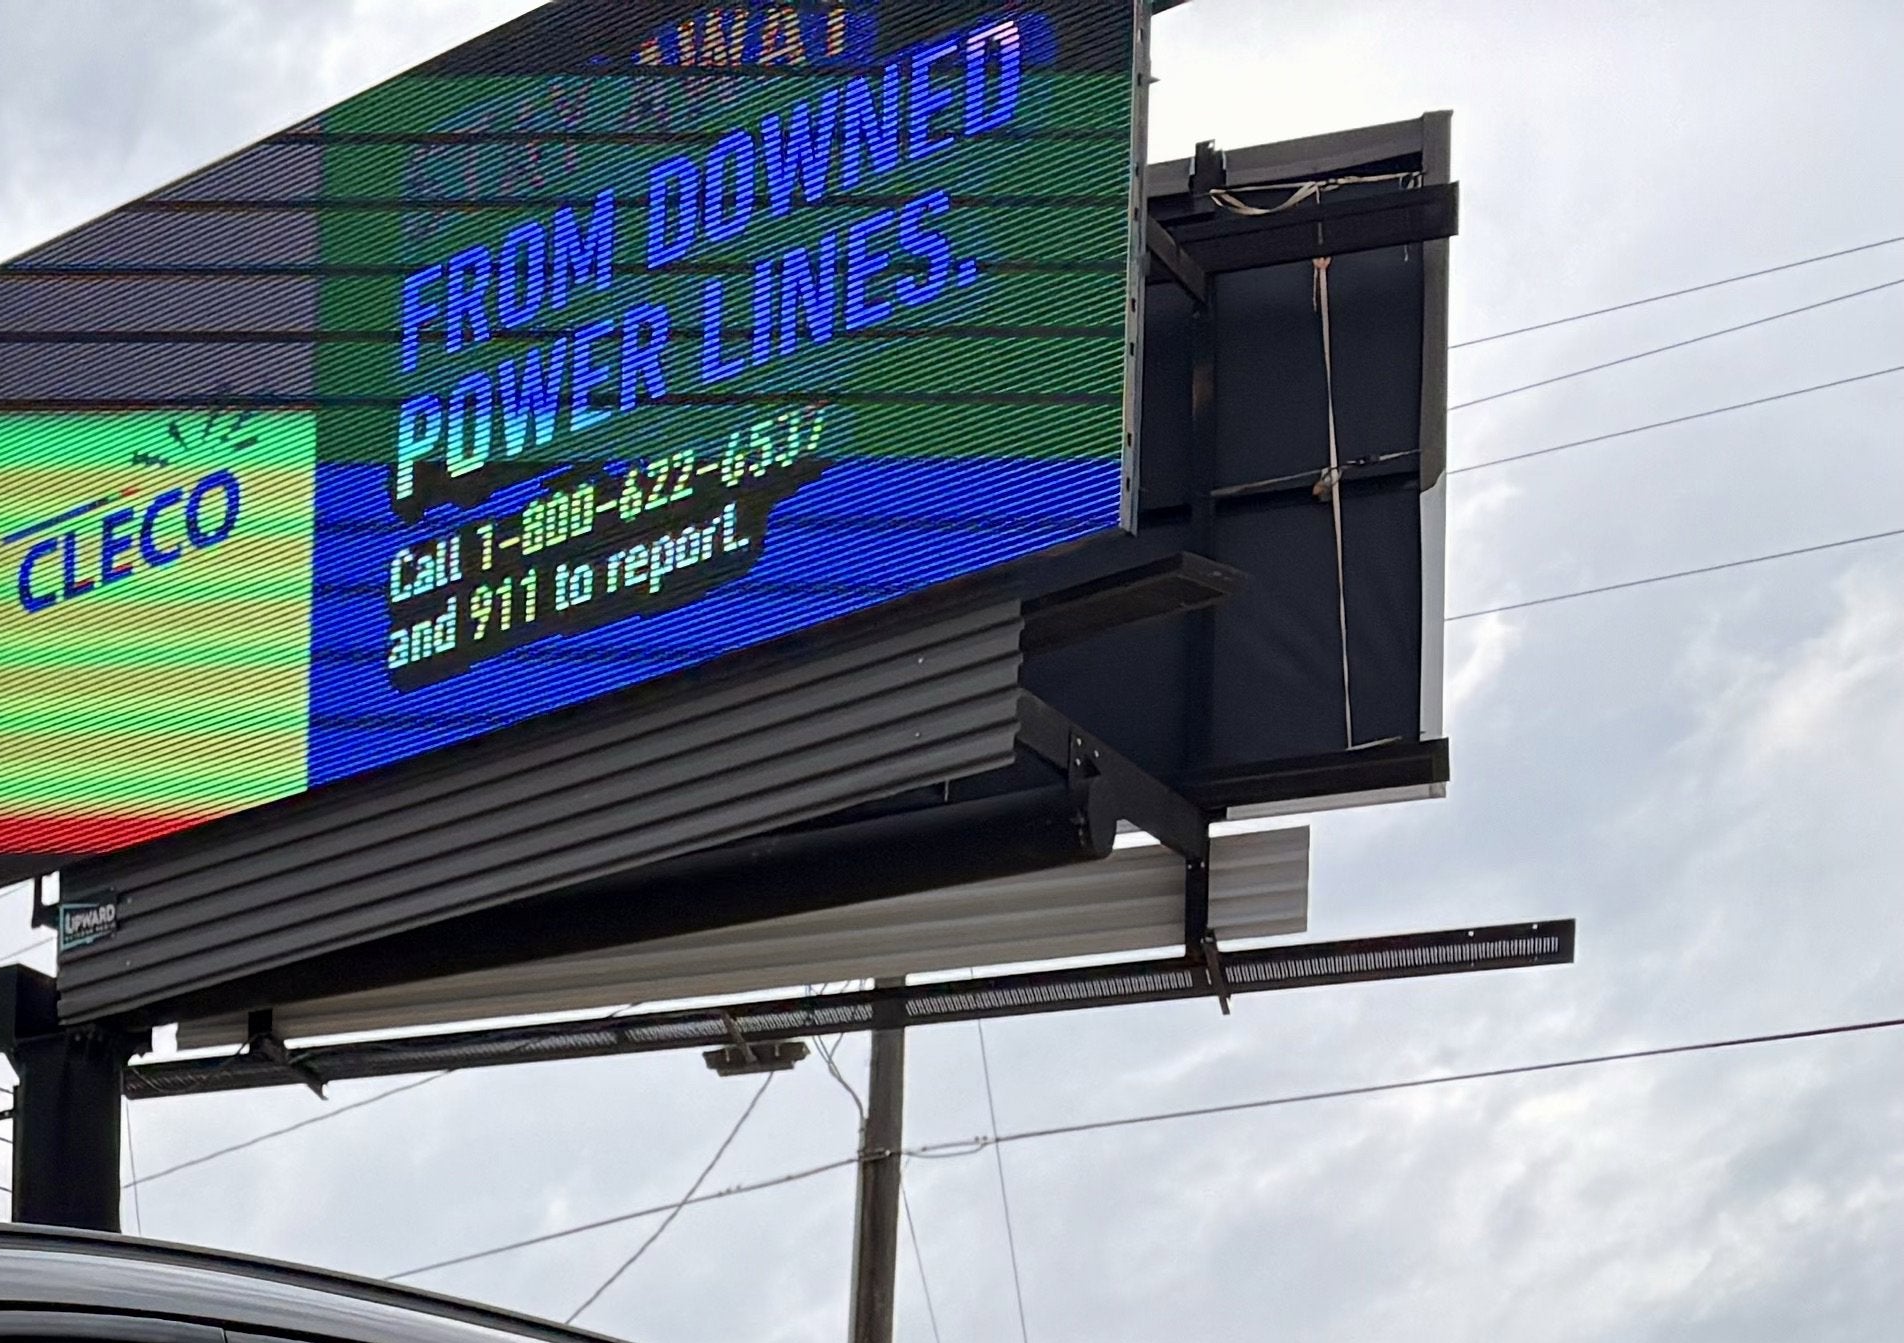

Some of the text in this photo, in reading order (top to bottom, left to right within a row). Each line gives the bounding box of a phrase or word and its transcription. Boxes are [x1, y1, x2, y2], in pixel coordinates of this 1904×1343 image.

[400, 20, 1021, 373] FROM DOWNED
[396, 190, 977, 499] POWER LINES.
[18, 468, 240, 614] CLECO
[390, 535, 462, 603] Call
[388, 597, 456, 668] and
[470, 569, 536, 640] 911
[555, 564, 593, 611] to
[64, 904, 116, 934] UPWARD
